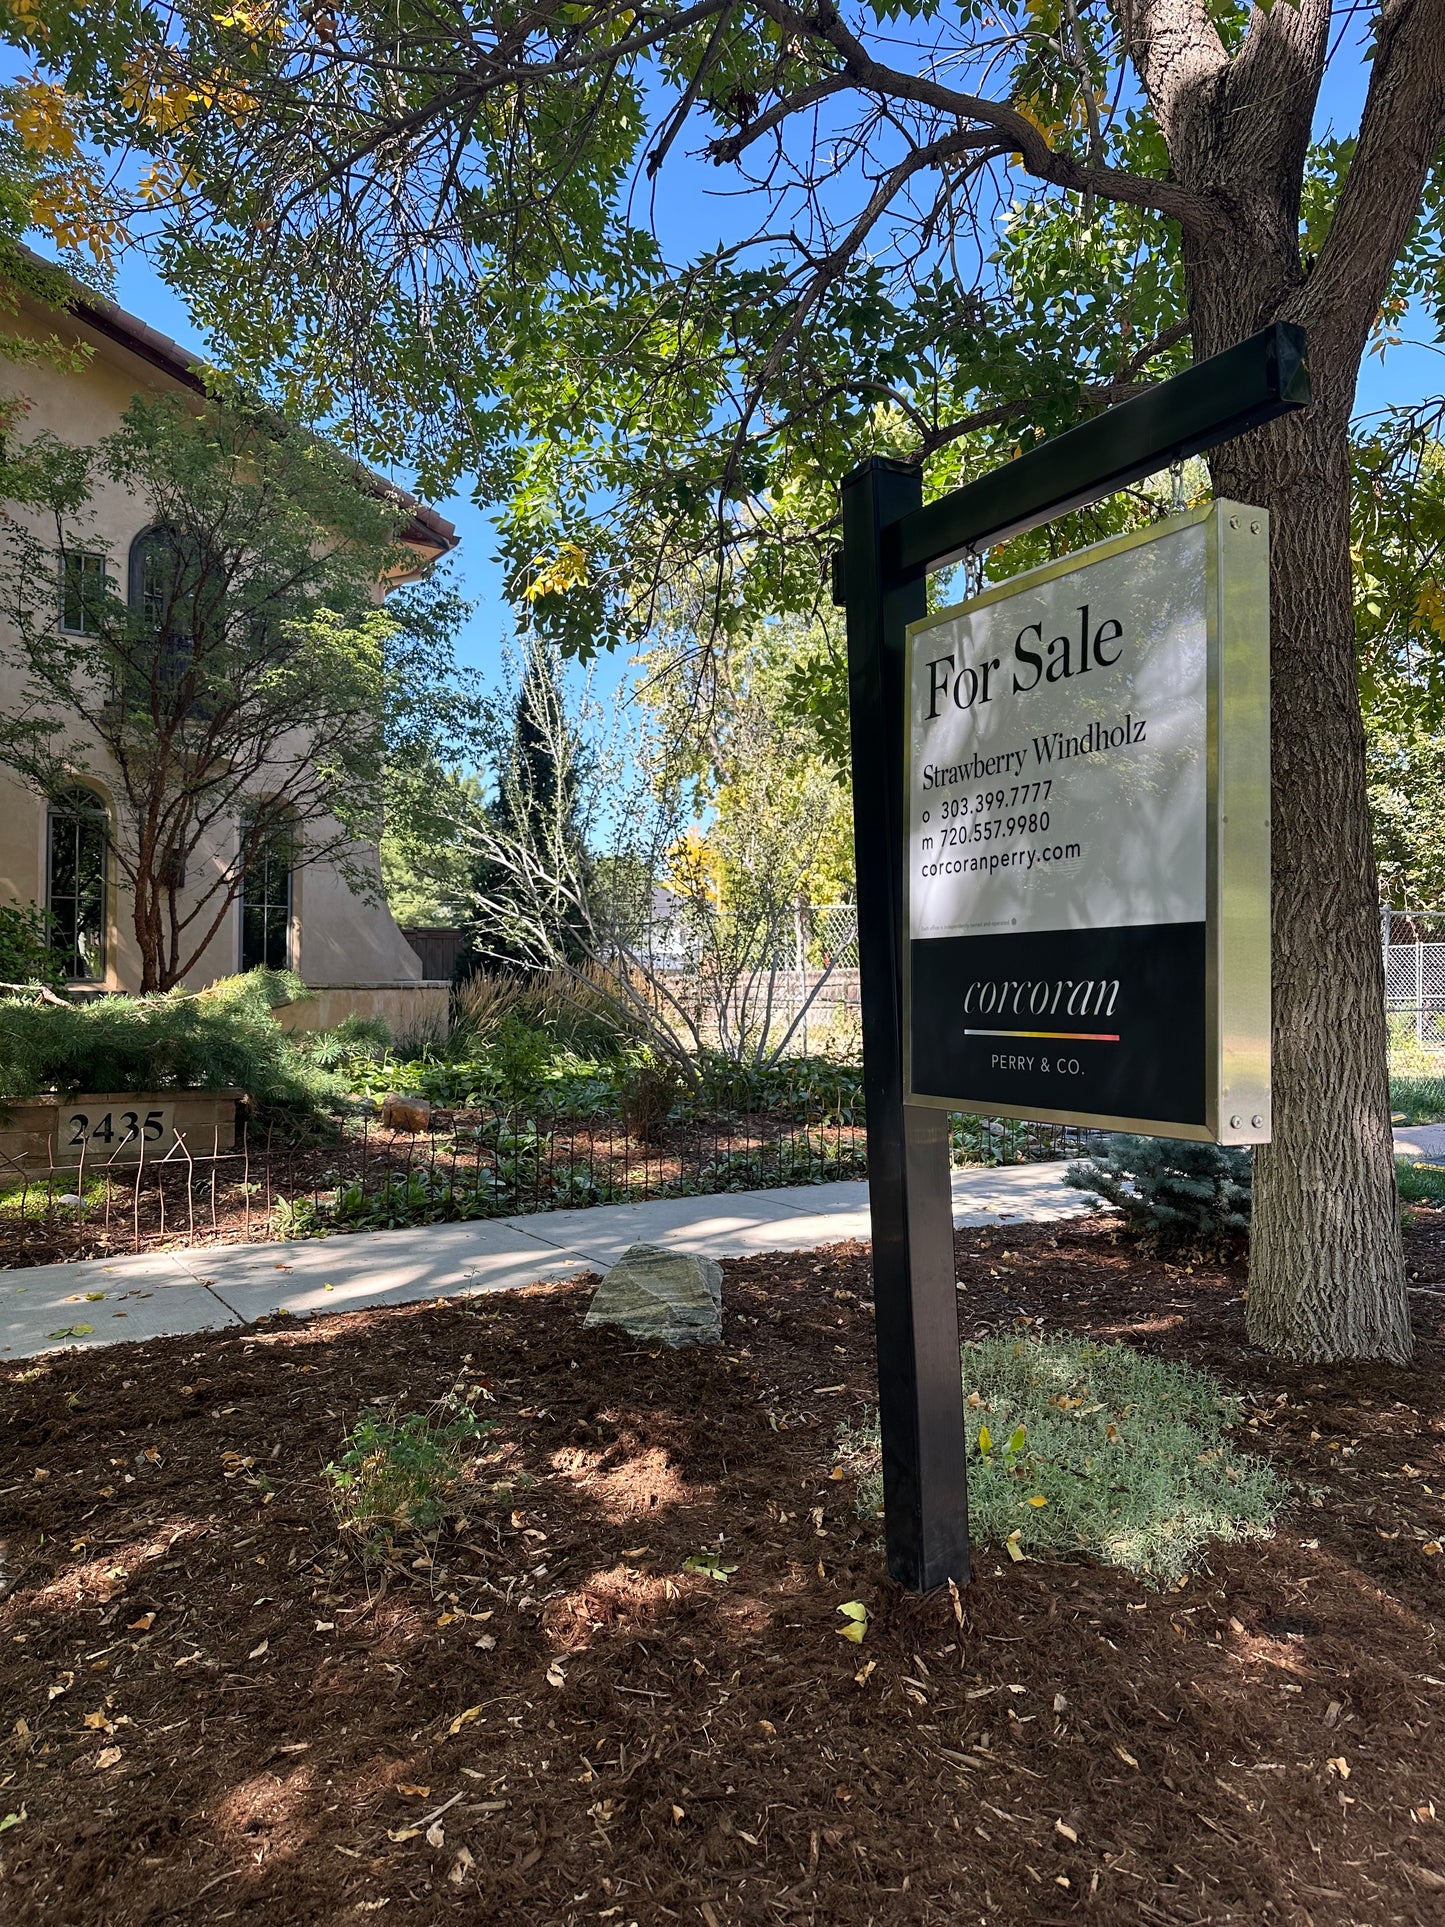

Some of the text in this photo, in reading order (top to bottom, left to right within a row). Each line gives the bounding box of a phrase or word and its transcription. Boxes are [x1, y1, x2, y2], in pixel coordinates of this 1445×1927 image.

[925, 604, 1123, 721] For Sale
[922, 714, 1147, 791] Strawberry Windholz
[921, 780, 1053, 823] o 303.399.7777
[921, 811, 1051, 850] m 720.557.9980
[921, 841, 1081, 876] corcoranperry.com
[964, 979, 1120, 1017] corcoran
[991, 1054, 1085, 1075] PERRY & CO.
[68, 1111, 164, 1146] 2435
